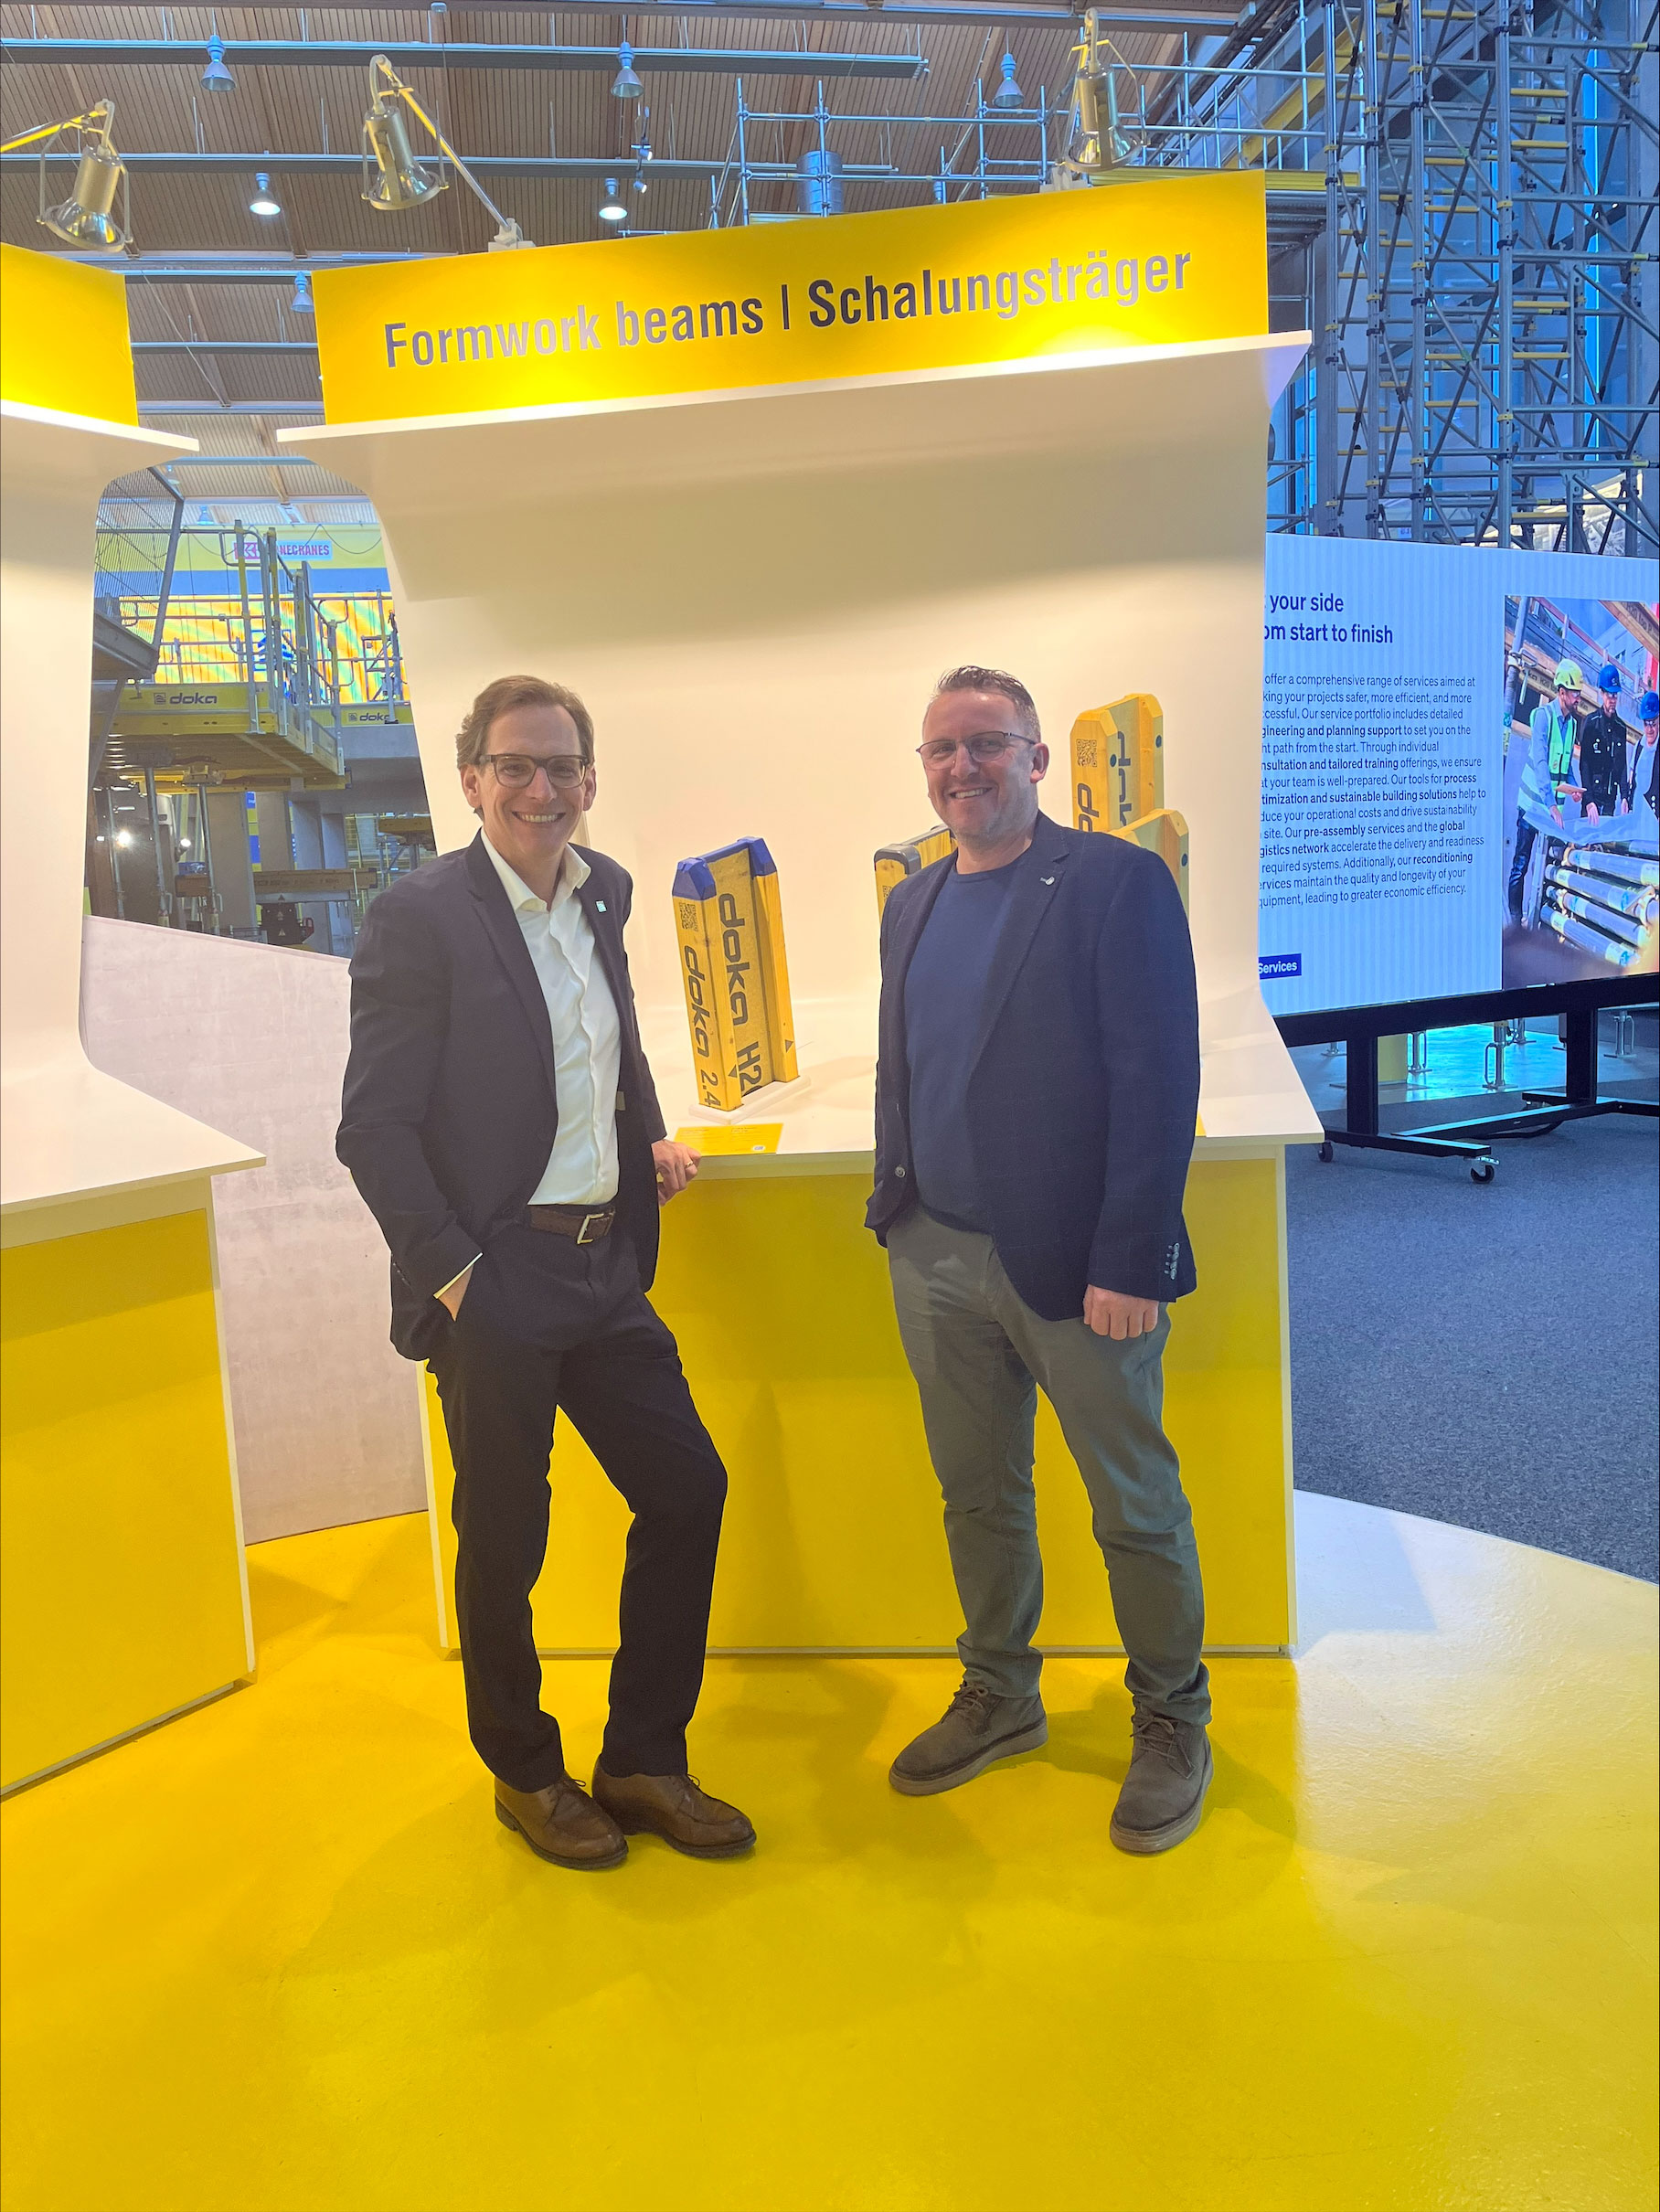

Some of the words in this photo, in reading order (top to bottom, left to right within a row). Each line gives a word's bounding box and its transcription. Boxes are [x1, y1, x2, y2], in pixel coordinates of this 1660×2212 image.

[384, 304, 602, 368] Formwork
[616, 297, 764, 346] beams
[808, 249, 1192, 328] Schalungsträger
[1270, 594, 1306, 613] your
[1311, 592, 1344, 611] side
[1290, 622, 1328, 641] start
[1332, 623, 1347, 642] to
[1351, 623, 1392, 643] finish
[1265, 673, 1286, 684] offer
[1296, 675, 1365, 686] comprehensive
[1367, 677, 1391, 688] range
[1394, 675, 1402, 686] of
[1404, 675, 1438, 686] services
[1441, 676, 1465, 686] aimed
[1468, 677, 1475, 686] at
[169, 692, 218, 705] doka
[1284, 694, 1305, 704] your
[1308, 691, 1344, 705] projects
[1433, 693, 1448, 702] and
[1451, 695, 1472, 703] more
[1263, 707, 1299, 719] cessful.
[1302, 708, 1318, 718] Our
[1321, 708, 1352, 718] service
[1355, 708, 1390, 721] portfolio
[1393, 708, 1428, 718] includes
[1431, 708, 1463, 718] detailed
[1307, 725, 1324, 735] and
[1326, 725, 1365, 738] planning
[1367, 725, 1402, 738] support
[1404, 725, 1412, 735] to
[1414, 725, 1427, 735] set
[1429, 727, 1443, 737] you
[1446, 727, 1455, 735] on
[1458, 725, 1471, 735] the
[1273, 742, 1293, 755] path
[1296, 742, 1316, 753] from
[1319, 742, 1333, 752] the
[1360, 741, 1397, 754] Through
[1399, 741, 1439, 751] individual
[1310, 759, 1326, 769] and
[1328, 758, 1362, 769] tailored
[1365, 758, 1398, 771] training
[1442, 758, 1452, 767] we
[1454, 758, 1481, 767] ensure
[1270, 778, 1290, 790] your
[1293, 776, 1315, 787] team
[1318, 776, 1325, 786] is
[1391, 774, 1407, 784] Our
[1409, 773, 1429, 784] tools
[1431, 773, 1442, 783] for
[1444, 774, 1476, 785] process
[1311, 792, 1327, 803] and
[1330, 791, 1380, 803] sustainable
[1383, 790, 1417, 803] building
[1420, 789, 1457, 800] solutions
[1459, 788, 1476, 801] help
[1478, 789, 1485, 798] to
[1284, 813, 1304, 824] your
[1306, 808, 1356, 822] operational
[1358, 808, 1381, 818] costs
[1384, 806, 1399, 816] and
[1401, 806, 1421, 816] drive
[1424, 804, 1477, 816] sustainability
[1285, 827, 1302, 837] Our
[1304, 824, 1366, 839] pre-assembly
[1367, 822, 1405, 834] services
[1407, 822, 1422, 832] and
[1424, 822, 1438, 832] the
[1440, 820, 1464, 833] global
[1293, 842, 1329, 854] network
[1332, 841, 1376, 852] accelerate
[1378, 839, 1392, 849] the
[1394, 837, 1426, 850] delivery
[1429, 836, 1443, 847] and
[1446, 836, 1484, 846] readiness
[1262, 858, 1300, 874] required
[1398, 856, 1411, 865] our
[1413, 852, 1473, 864] reconditioning
[1294, 876, 1332, 888] maintain
[1335, 875, 1348, 885] the
[1350, 873, 1379, 887] quality
[1381, 871, 1397, 882] and
[1399, 869, 1436, 882] longevity
[1439, 868, 1446, 878] of
[1448, 869, 1465, 880] your
[1305, 891, 1337, 904] leading
[1340, 891, 1348, 901] to
[1351, 888, 1382, 902] greater
[1384, 886, 1424, 898] economic
[1258, 961, 1298, 974] Services
[684, 944, 711, 1058] doka
[718, 892, 750, 1026] doka
[736, 1040, 763, 1097] H2
